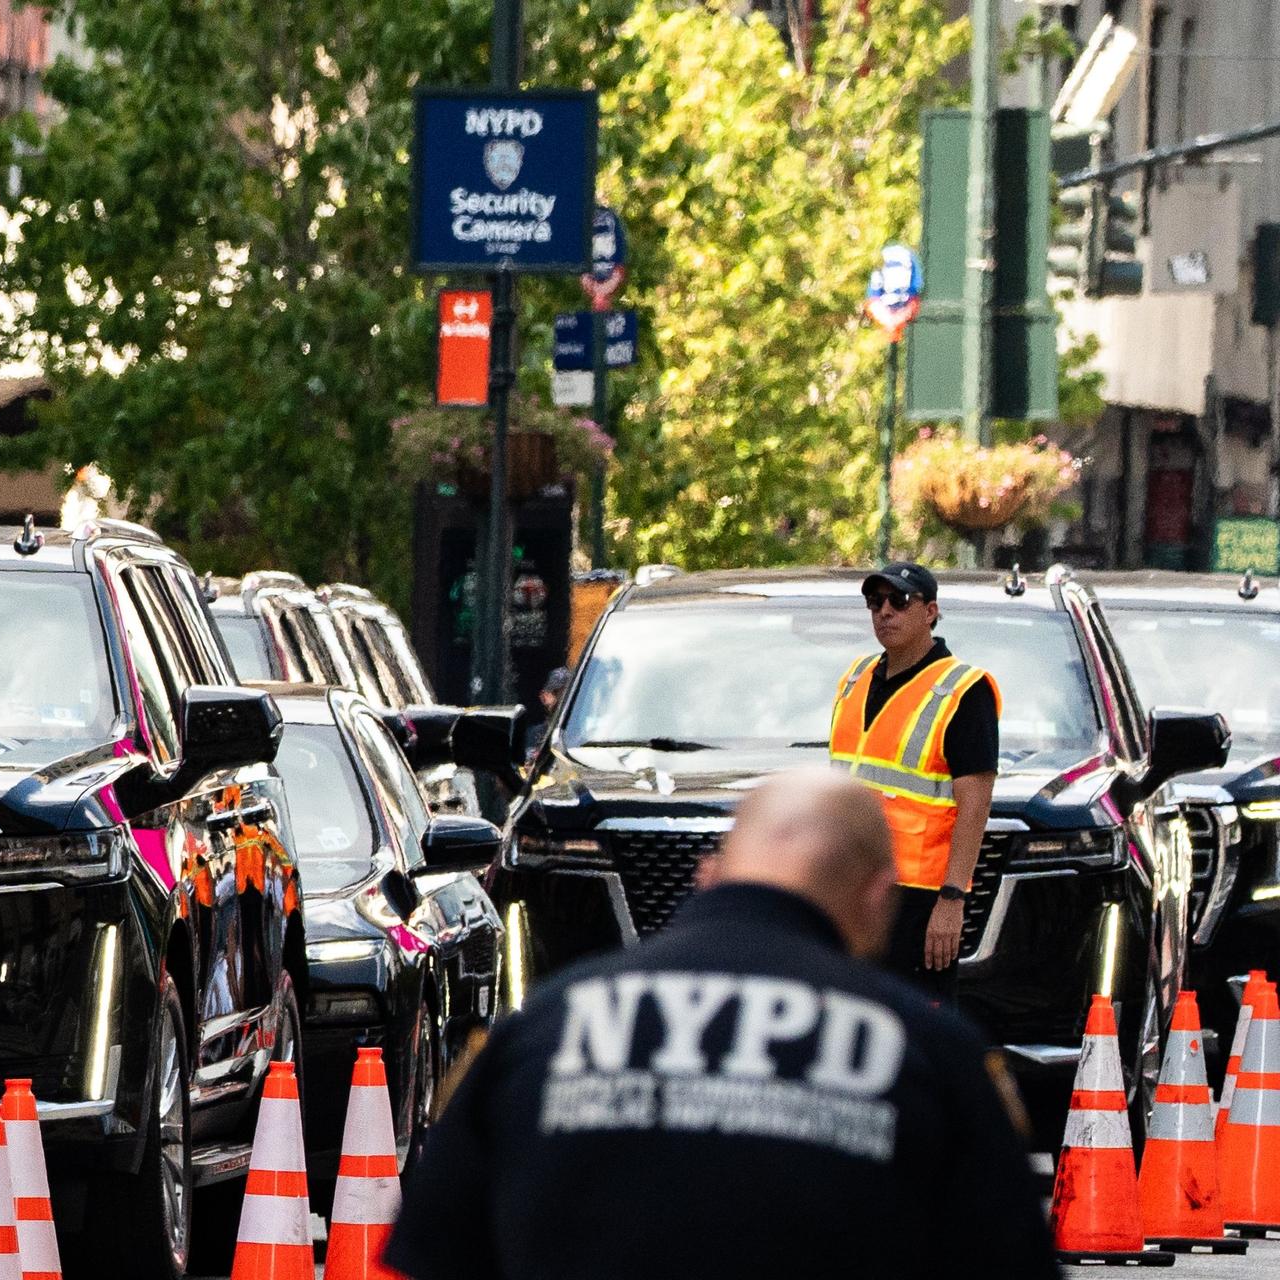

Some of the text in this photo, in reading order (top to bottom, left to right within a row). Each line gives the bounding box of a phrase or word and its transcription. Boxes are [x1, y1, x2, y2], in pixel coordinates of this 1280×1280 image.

[465, 108, 544, 138] NYPD
[449, 186, 557, 222] Security
[451, 214, 552, 243] Camera
[548, 969, 908, 1098] NYPD
